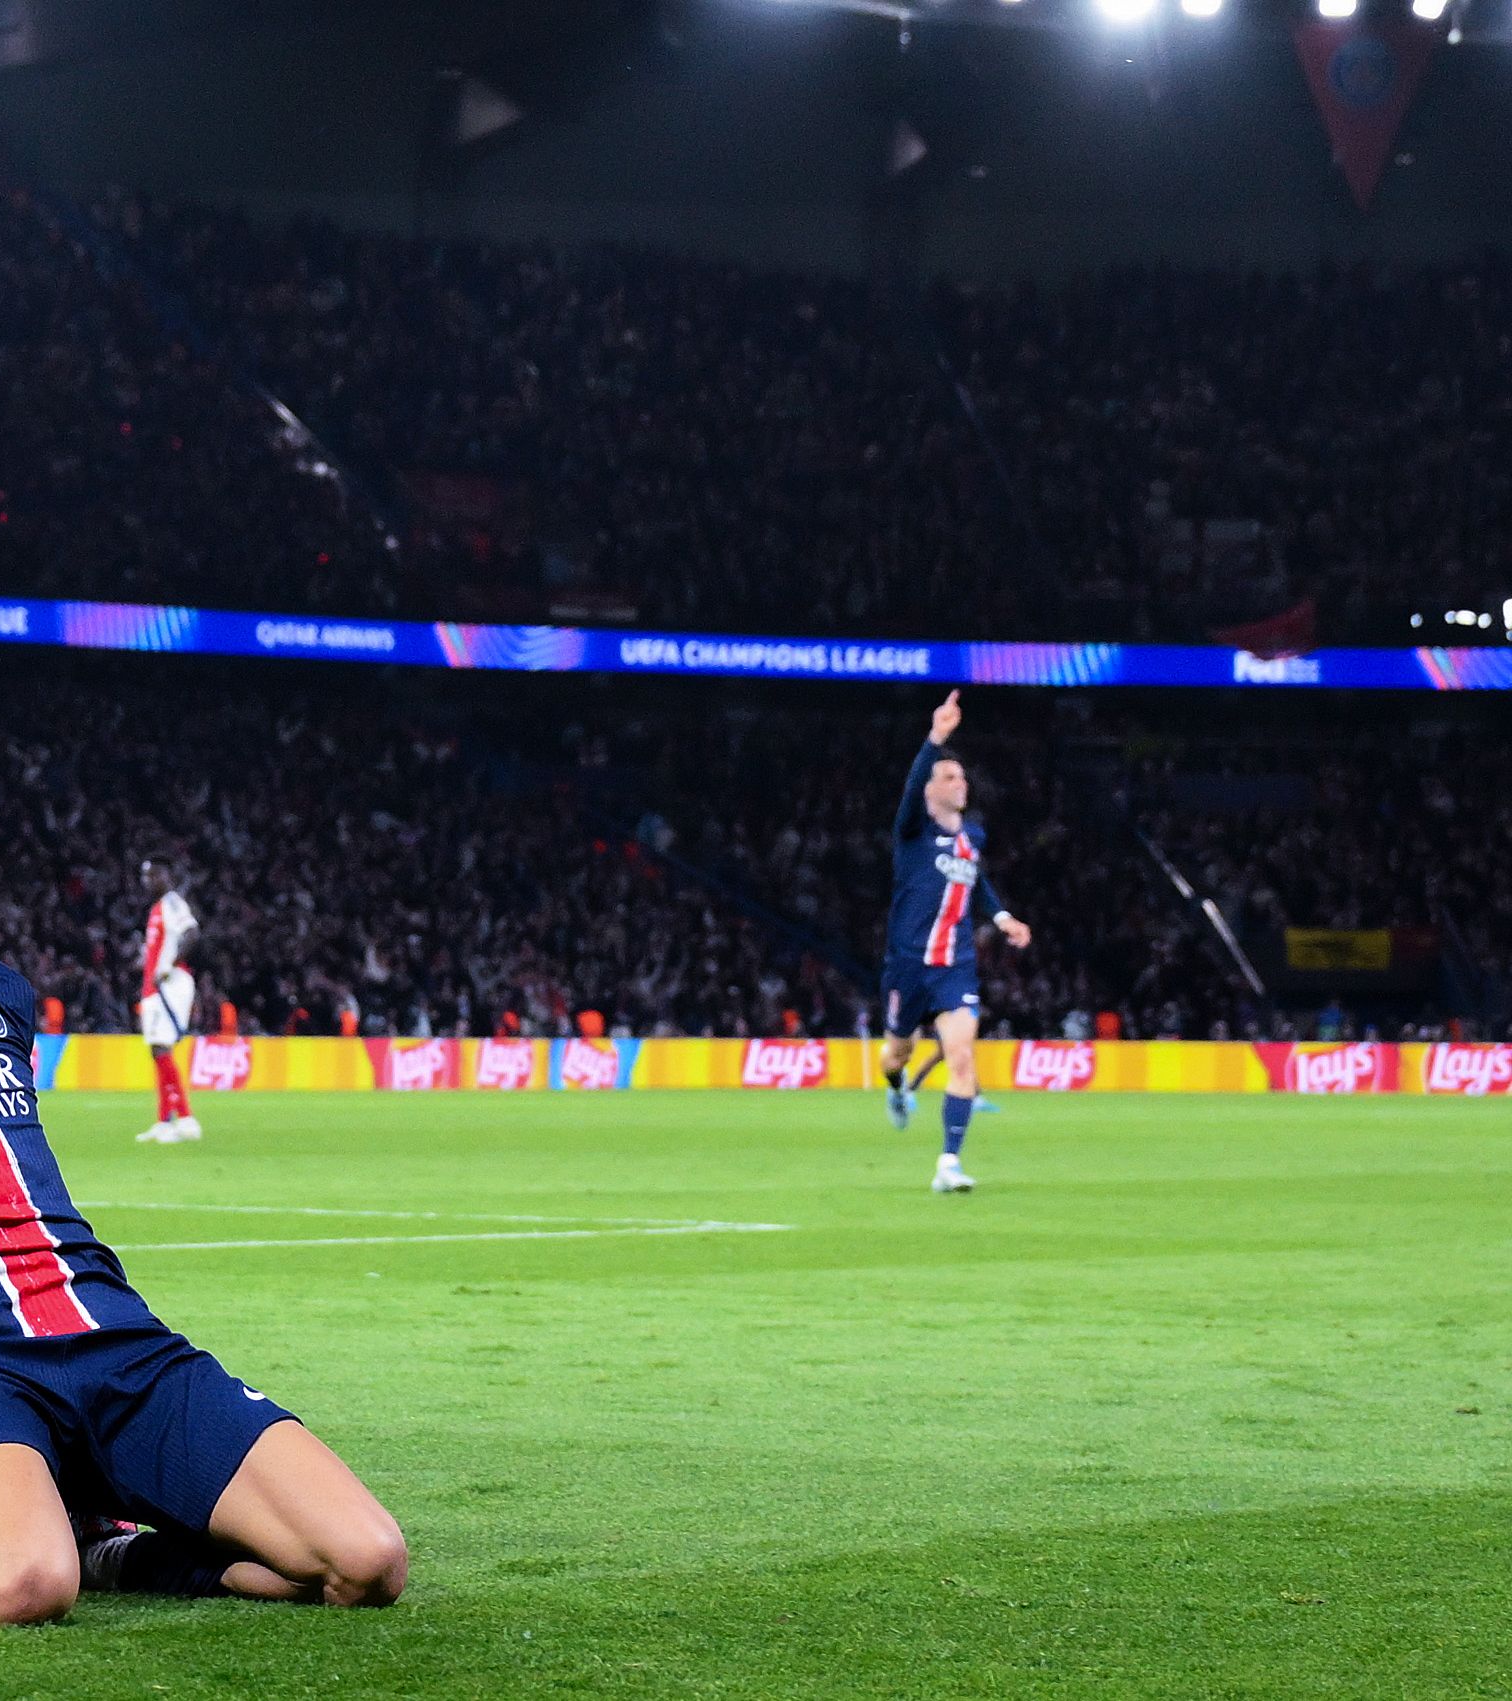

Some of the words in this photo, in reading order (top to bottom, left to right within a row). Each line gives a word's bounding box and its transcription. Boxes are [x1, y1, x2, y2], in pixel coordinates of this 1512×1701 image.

[620, 638, 682, 667] UEFA
[683, 640, 828, 673] CHAMPIONS
[830, 645, 931, 675] LEAGUE
[742, 1038, 825, 1090] Lay's
